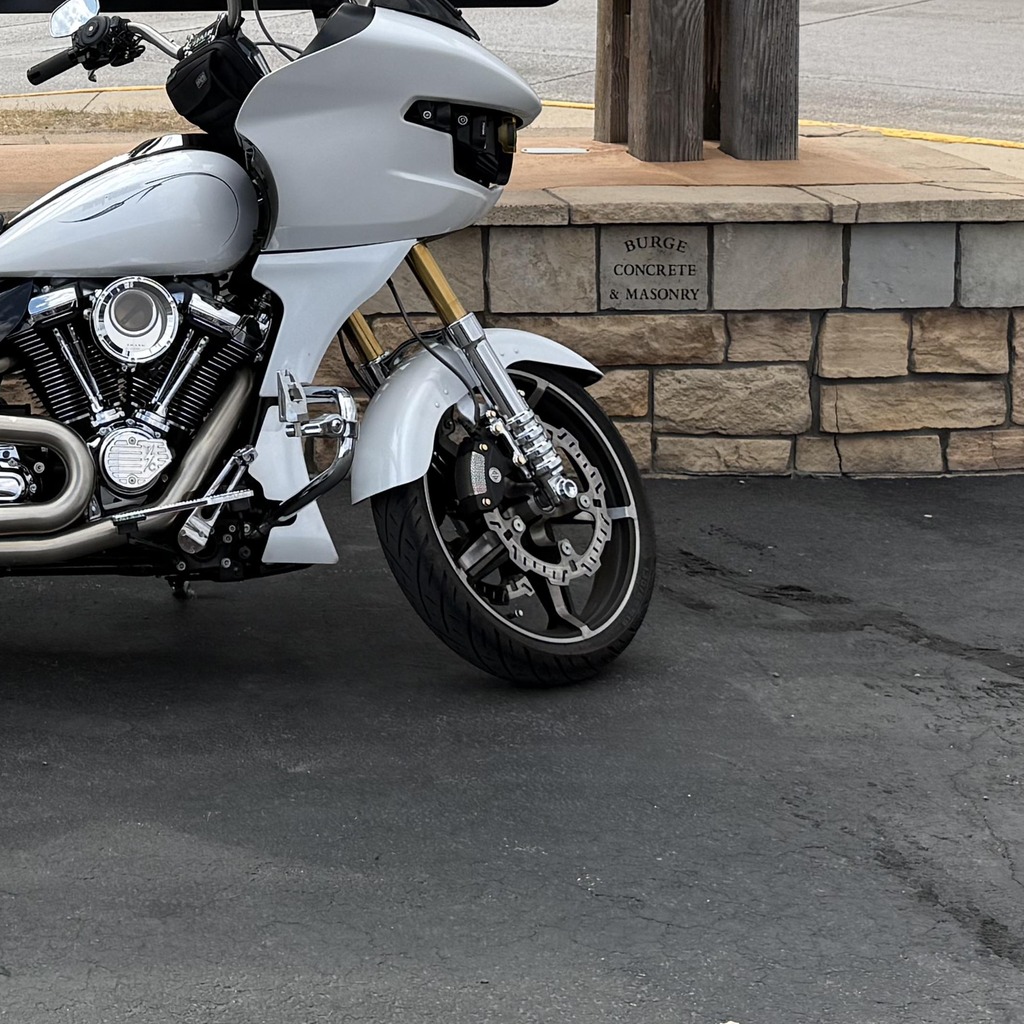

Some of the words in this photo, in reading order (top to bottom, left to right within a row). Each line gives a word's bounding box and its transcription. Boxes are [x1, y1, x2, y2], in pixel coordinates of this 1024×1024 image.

[623, 236, 688, 253] BURGE
[613, 264, 696, 276] CONCRETE
[609, 288, 619, 300] &
[625, 288, 699, 300] MASONRY
